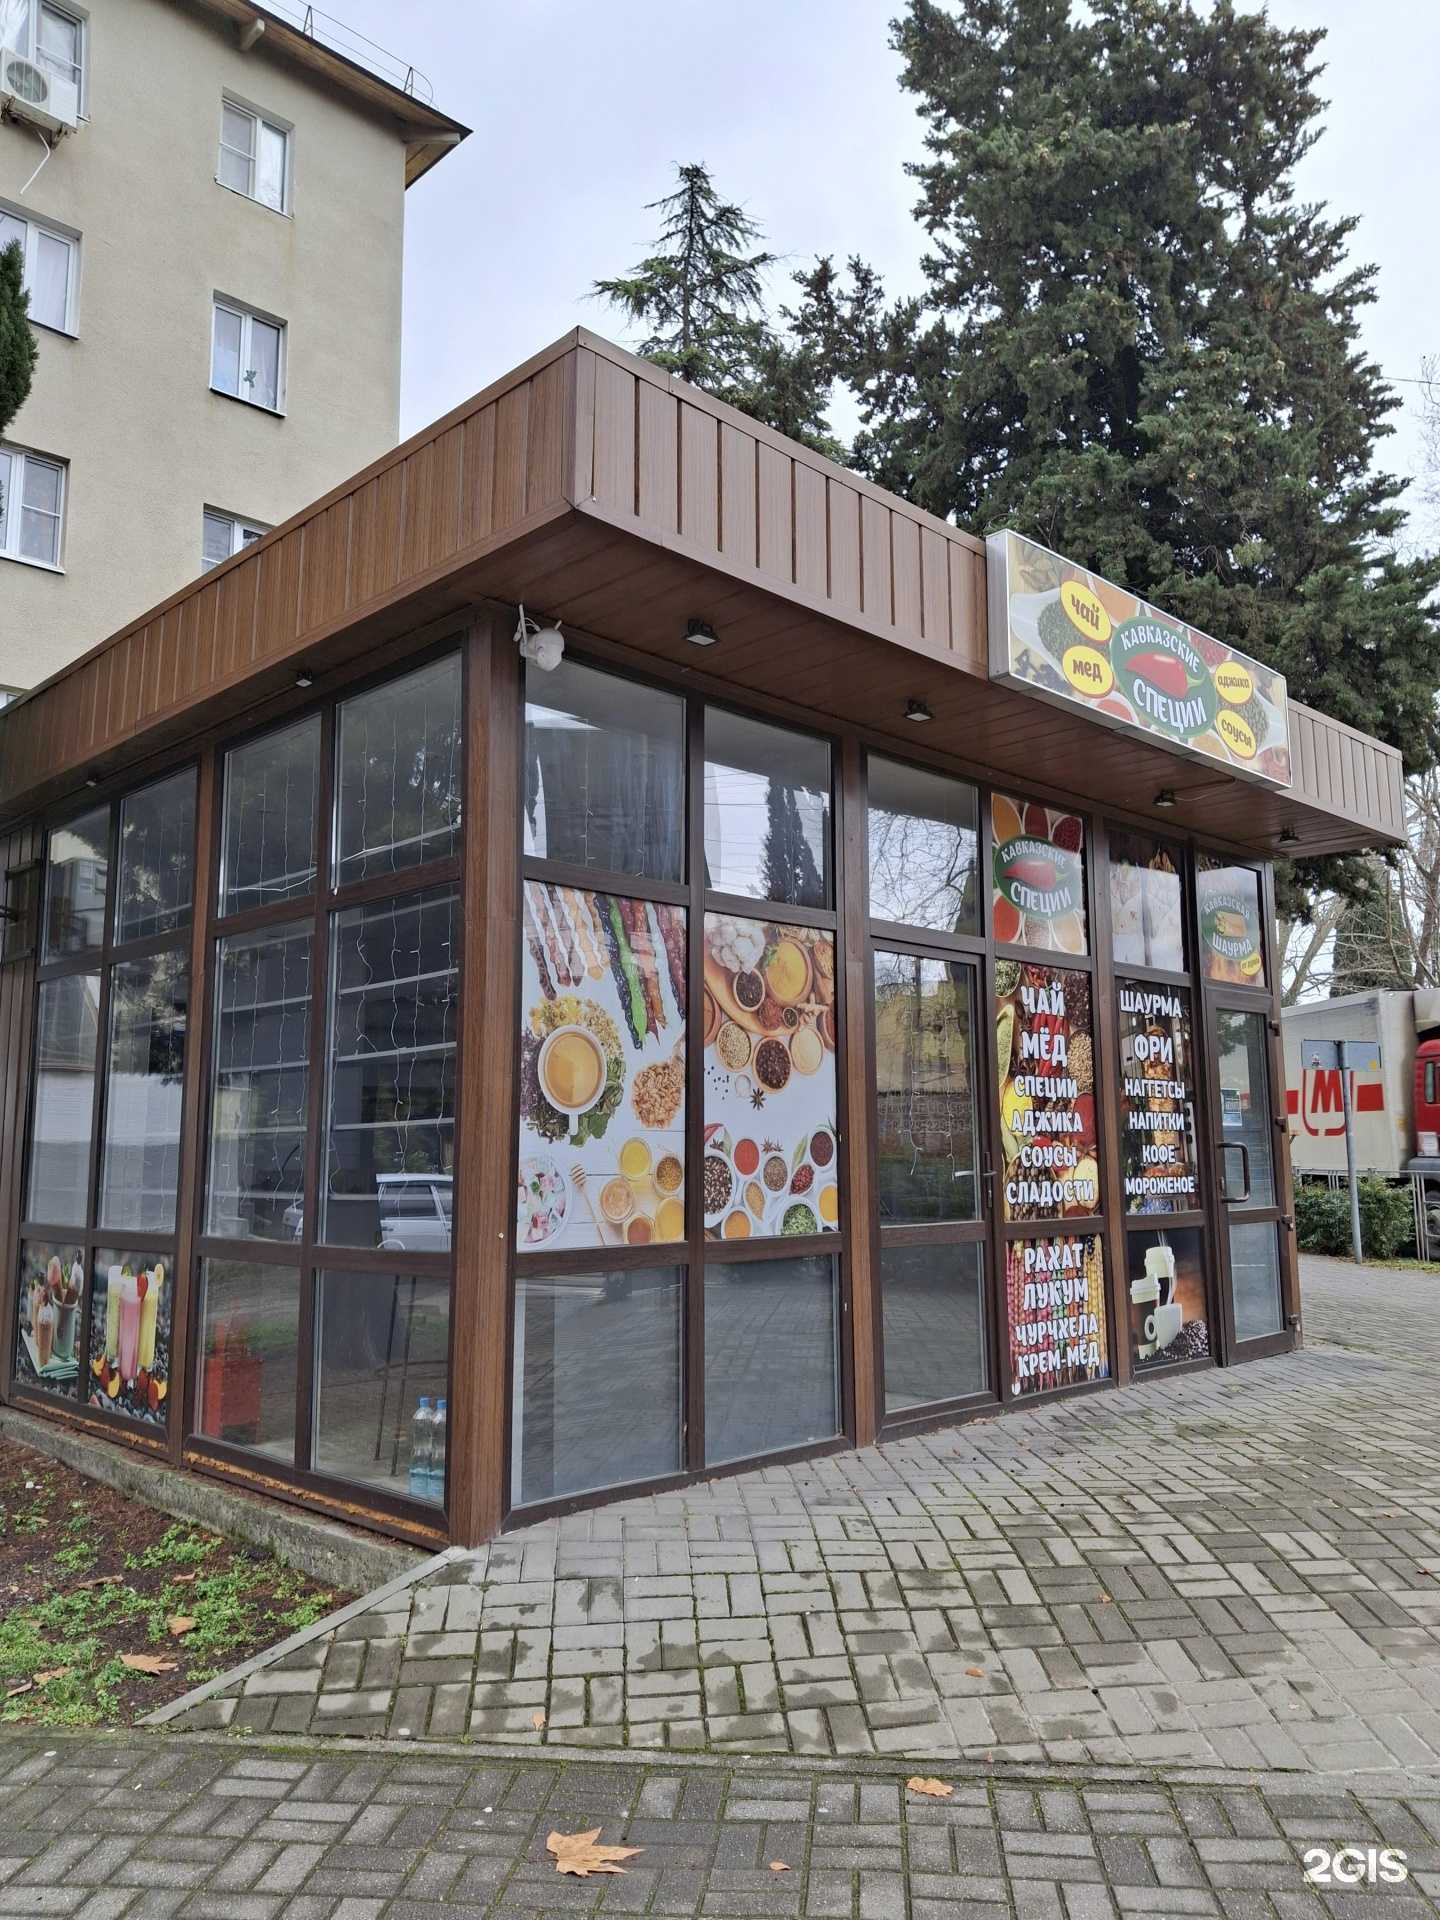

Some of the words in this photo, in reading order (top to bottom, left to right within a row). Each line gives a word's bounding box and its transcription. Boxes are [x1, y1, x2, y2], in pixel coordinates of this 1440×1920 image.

[1070, 593, 1101, 632] чай
[1120, 623, 1201, 673] КАВКАЗСКИЕ
[1072, 657, 1103, 684] мед
[1217, 675, 1250, 689] аджика
[1132, 678, 1207, 733] СПЕЦИИ
[1221, 718, 1252, 748] соусы
[1000, 840, 1067, 870] КАВКАЗСКИЕ
[1010, 881, 1072, 916] СПЕЦИИ
[1212, 932, 1253, 958] ШАУРМА
[1020, 981, 1066, 1017] ЧАЙ
[1119, 989, 1182, 1018] ШАУРМА
[1021, 1027, 1067, 1067] МЁД
[1134, 1033, 1174, 1064] ФРИ
[1014, 1075, 1078, 1101] СПЕЦИИ
[1124, 1078, 1186, 1099] НАГГЕТСЫ
[1011, 1109, 1083, 1136] АДЖИКА
[1129, 1111, 1185, 1131] НАПИТКИ
[1020, 1146, 1078, 1168] СОУСЫ
[1141, 1145, 1176, 1164] КОФЕ
[1006, 1179, 1095, 1207] СЛАДОСТИ
[1125, 1176, 1196, 1195] МОРОЖЕНОЕ
[1023, 1242, 1084, 1274] РАХАТ
[1023, 1277, 1089, 1311] ЛУКУМ
[1015, 1312, 1099, 1347] ЧУРЧХЕЛА
[1017, 1340, 1100, 1378] КРЕМ-МЁД
